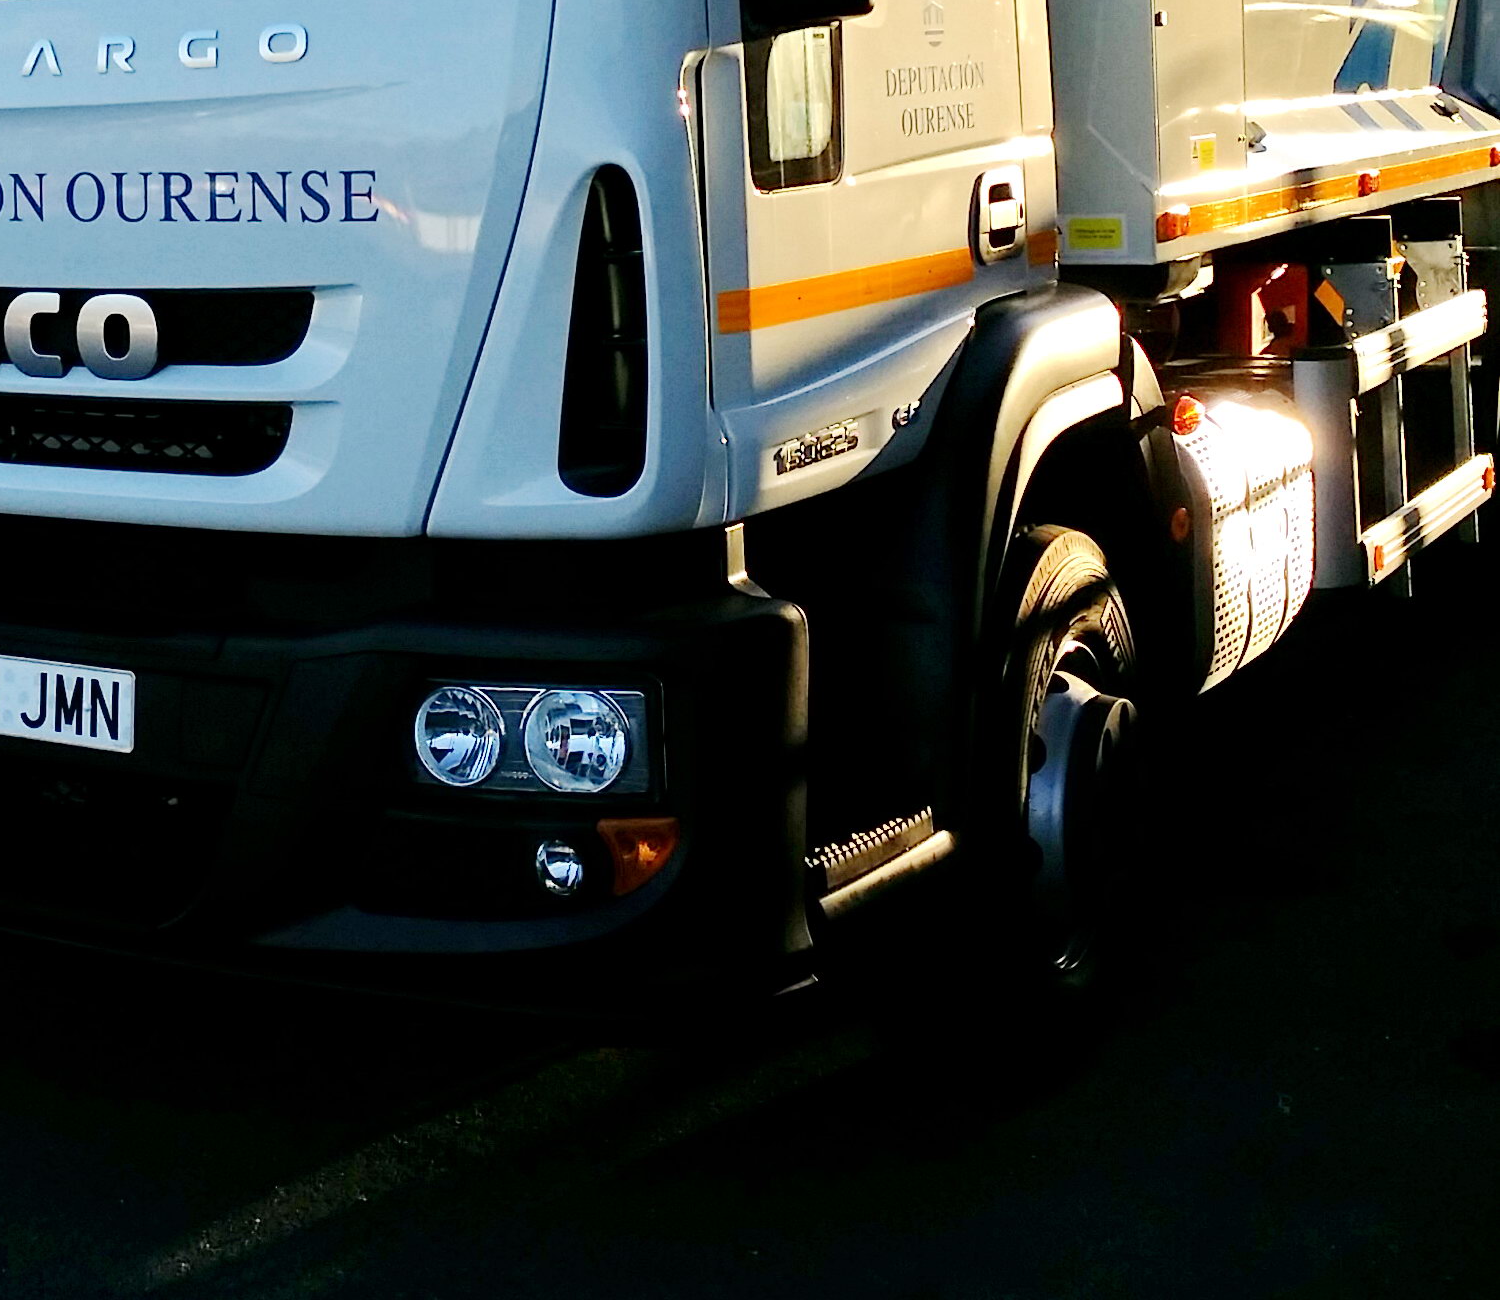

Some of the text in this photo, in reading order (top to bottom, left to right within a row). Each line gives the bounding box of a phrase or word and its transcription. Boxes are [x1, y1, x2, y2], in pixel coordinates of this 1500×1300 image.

[886, 54, 984, 97] DEPUTACIÓN
[901, 102, 976, 138] OURENSE
[65, 169, 380, 225] OURENSE
[20, 672, 121, 741] JMN
